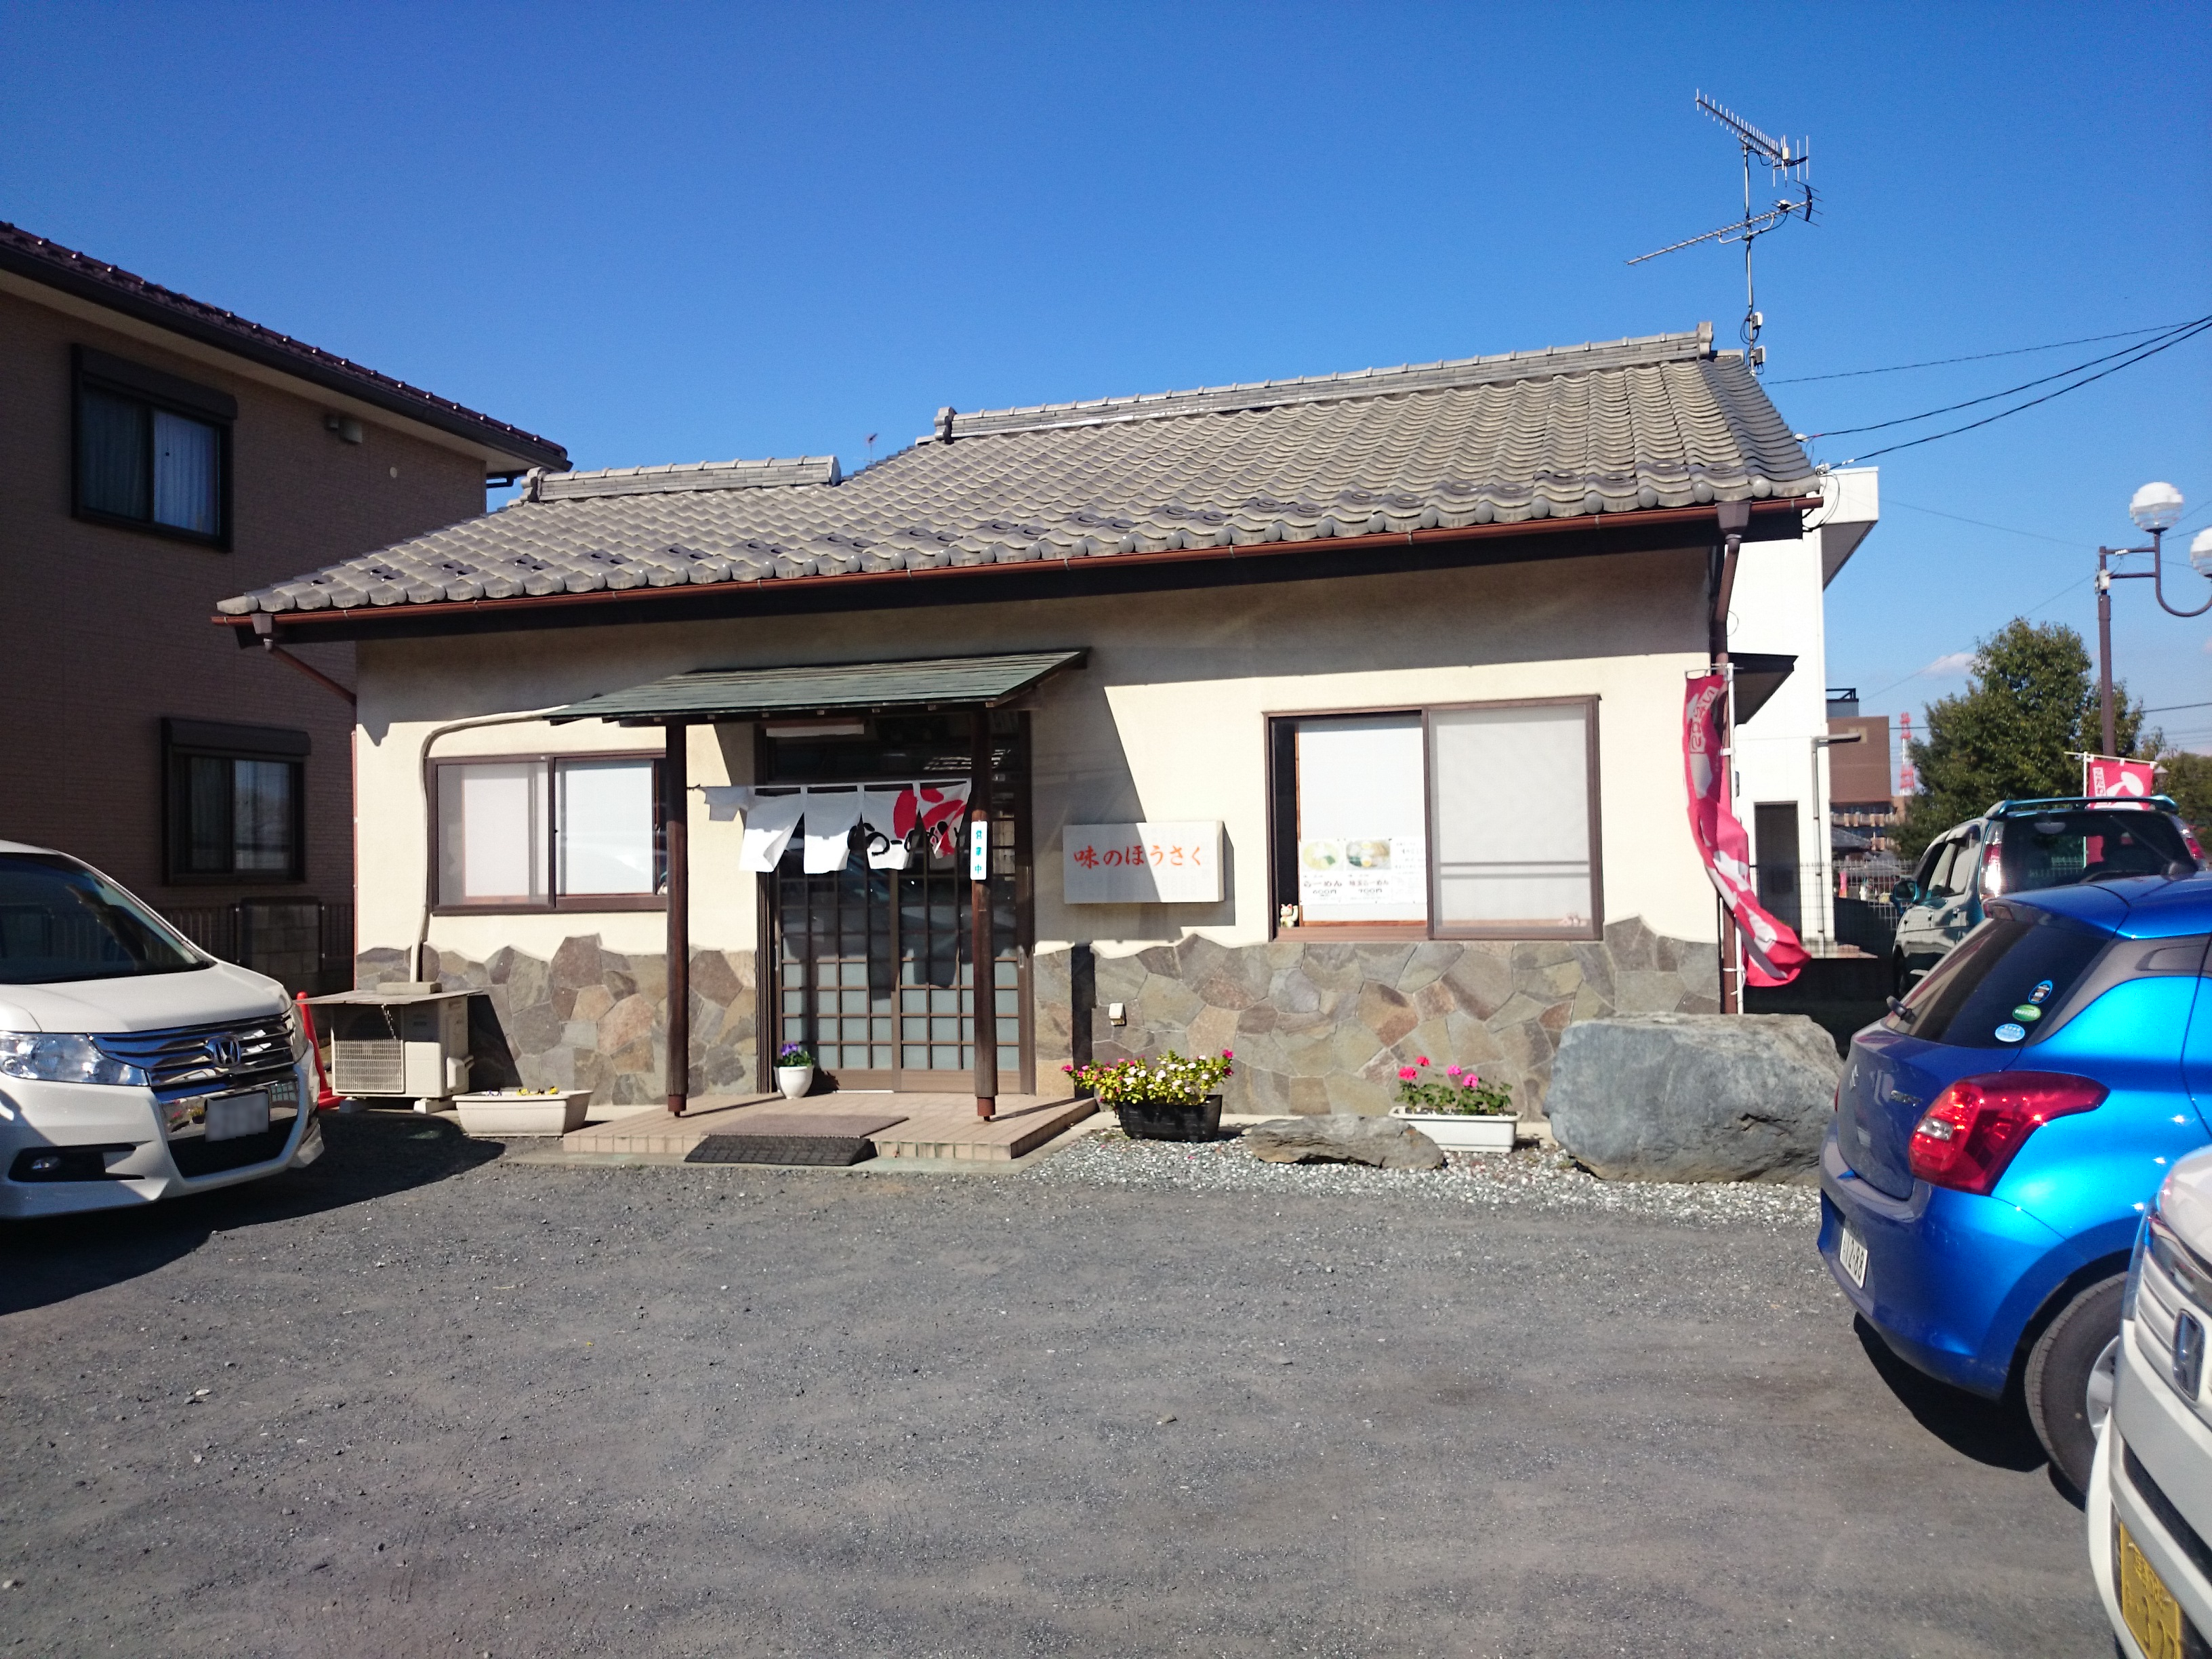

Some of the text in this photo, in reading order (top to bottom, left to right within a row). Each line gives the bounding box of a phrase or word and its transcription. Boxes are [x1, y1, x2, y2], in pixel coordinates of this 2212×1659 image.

[1073, 844, 1201, 869] 味のほうさく
